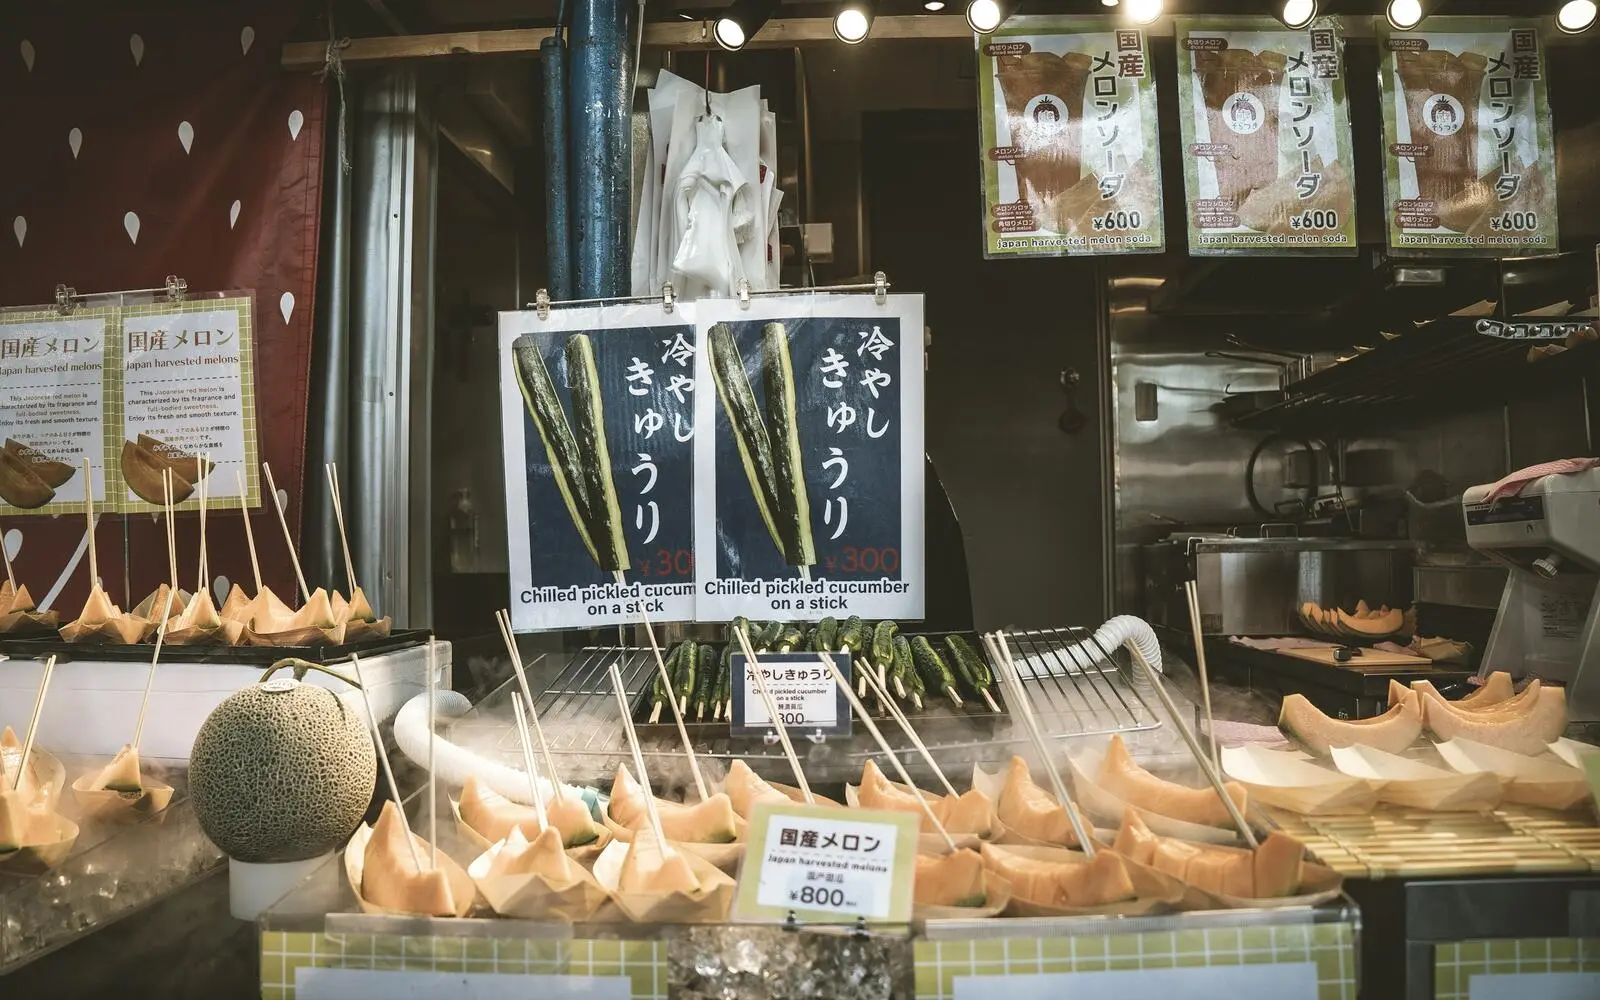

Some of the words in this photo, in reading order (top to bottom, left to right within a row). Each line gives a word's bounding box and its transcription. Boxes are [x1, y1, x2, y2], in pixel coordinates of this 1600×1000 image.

[1116, 30, 1144, 78] 国産
[1311, 29, 1338, 78] 国産
[1512, 29, 1540, 80] 国産
[1093, 51, 1124, 199] メロンソーダ
[1288, 51, 1320, 198] メロンソーダ
[1488, 52, 1520, 199] メロンソーダ
[1093, 211, 1141, 230] ¥600
[1291, 211, 1337, 228] ¥600
[1491, 212, 1537, 230] ¥600
[998, 240, 1028, 248] japan
[1032, 237, 1086, 247] harvested
[1090, 236, 1122, 245] melon
[1126, 235, 1150, 243] soda
[1200, 235, 1228, 244] japan
[1232, 234, 1284, 243] harvested
[1288, 234, 1318, 243] melon
[1323, 234, 1346, 242] soda
[1400, 236, 1428, 244] japan
[1432, 235, 1484, 244] harvested
[1488, 235, 1518, 244] melon
[1523, 235, 1546, 244] soda
[2, 336, 99, 360] 国産メロン
[128, 328, 234, 353] 国産メロン
[26, 362, 68, 374] harvested
[70, 362, 102, 372] melons
[155, 356, 202, 368] harvested
[204, 354, 238, 364] melons
[661, 333, 695, 442] 冷やし
[857, 326, 895, 438] 冷やし
[147, 404, 182, 412] full-bodied
[625, 357, 663, 544] きゅうり
[820, 348, 856, 540] きゅうり
[825, 546, 898, 573] ¥300
[520, 587, 577, 604] Chilled
[582, 584, 640, 603] pickled
[704, 580, 760, 595] Chilled
[766, 580, 824, 598] pickled
[829, 580, 910, 594] cucumber
[588, 604, 606, 616] on
[612, 603, 621, 614] a
[626, 600, 664, 614] stck
[771, 598, 790, 610] on
[796, 598, 805, 609] a
[810, 596, 848, 610] stick
[780, 828, 881, 852] 国産メロン
[799, 858, 848, 869] harvested
[790, 886, 844, 906] ¥800
